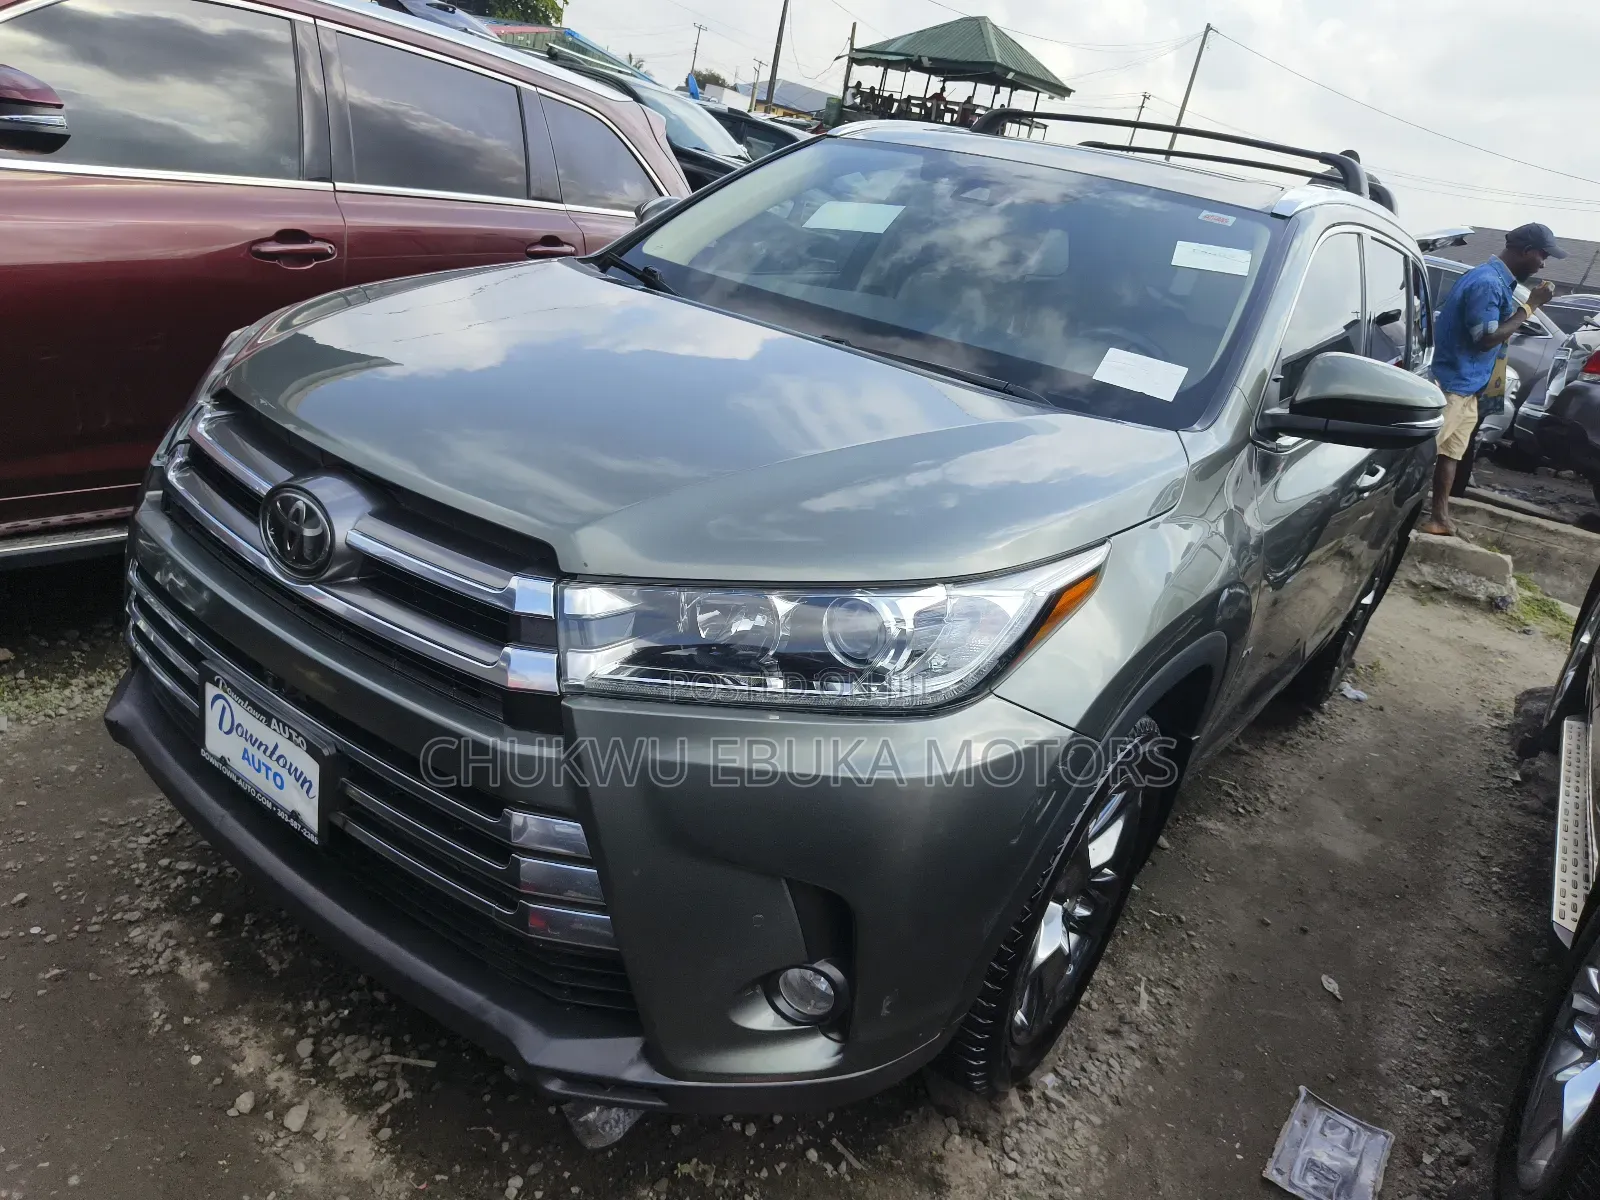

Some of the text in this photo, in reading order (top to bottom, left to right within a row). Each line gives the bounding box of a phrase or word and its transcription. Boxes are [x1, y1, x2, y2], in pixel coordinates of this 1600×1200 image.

[210, 693, 317, 799] Downtown
[214, 675, 307, 751] Downtown AUTO
[200, 748, 272, 811] DOWNTOWN-AUTO.COM
[241, 747, 285, 791] AUTO
